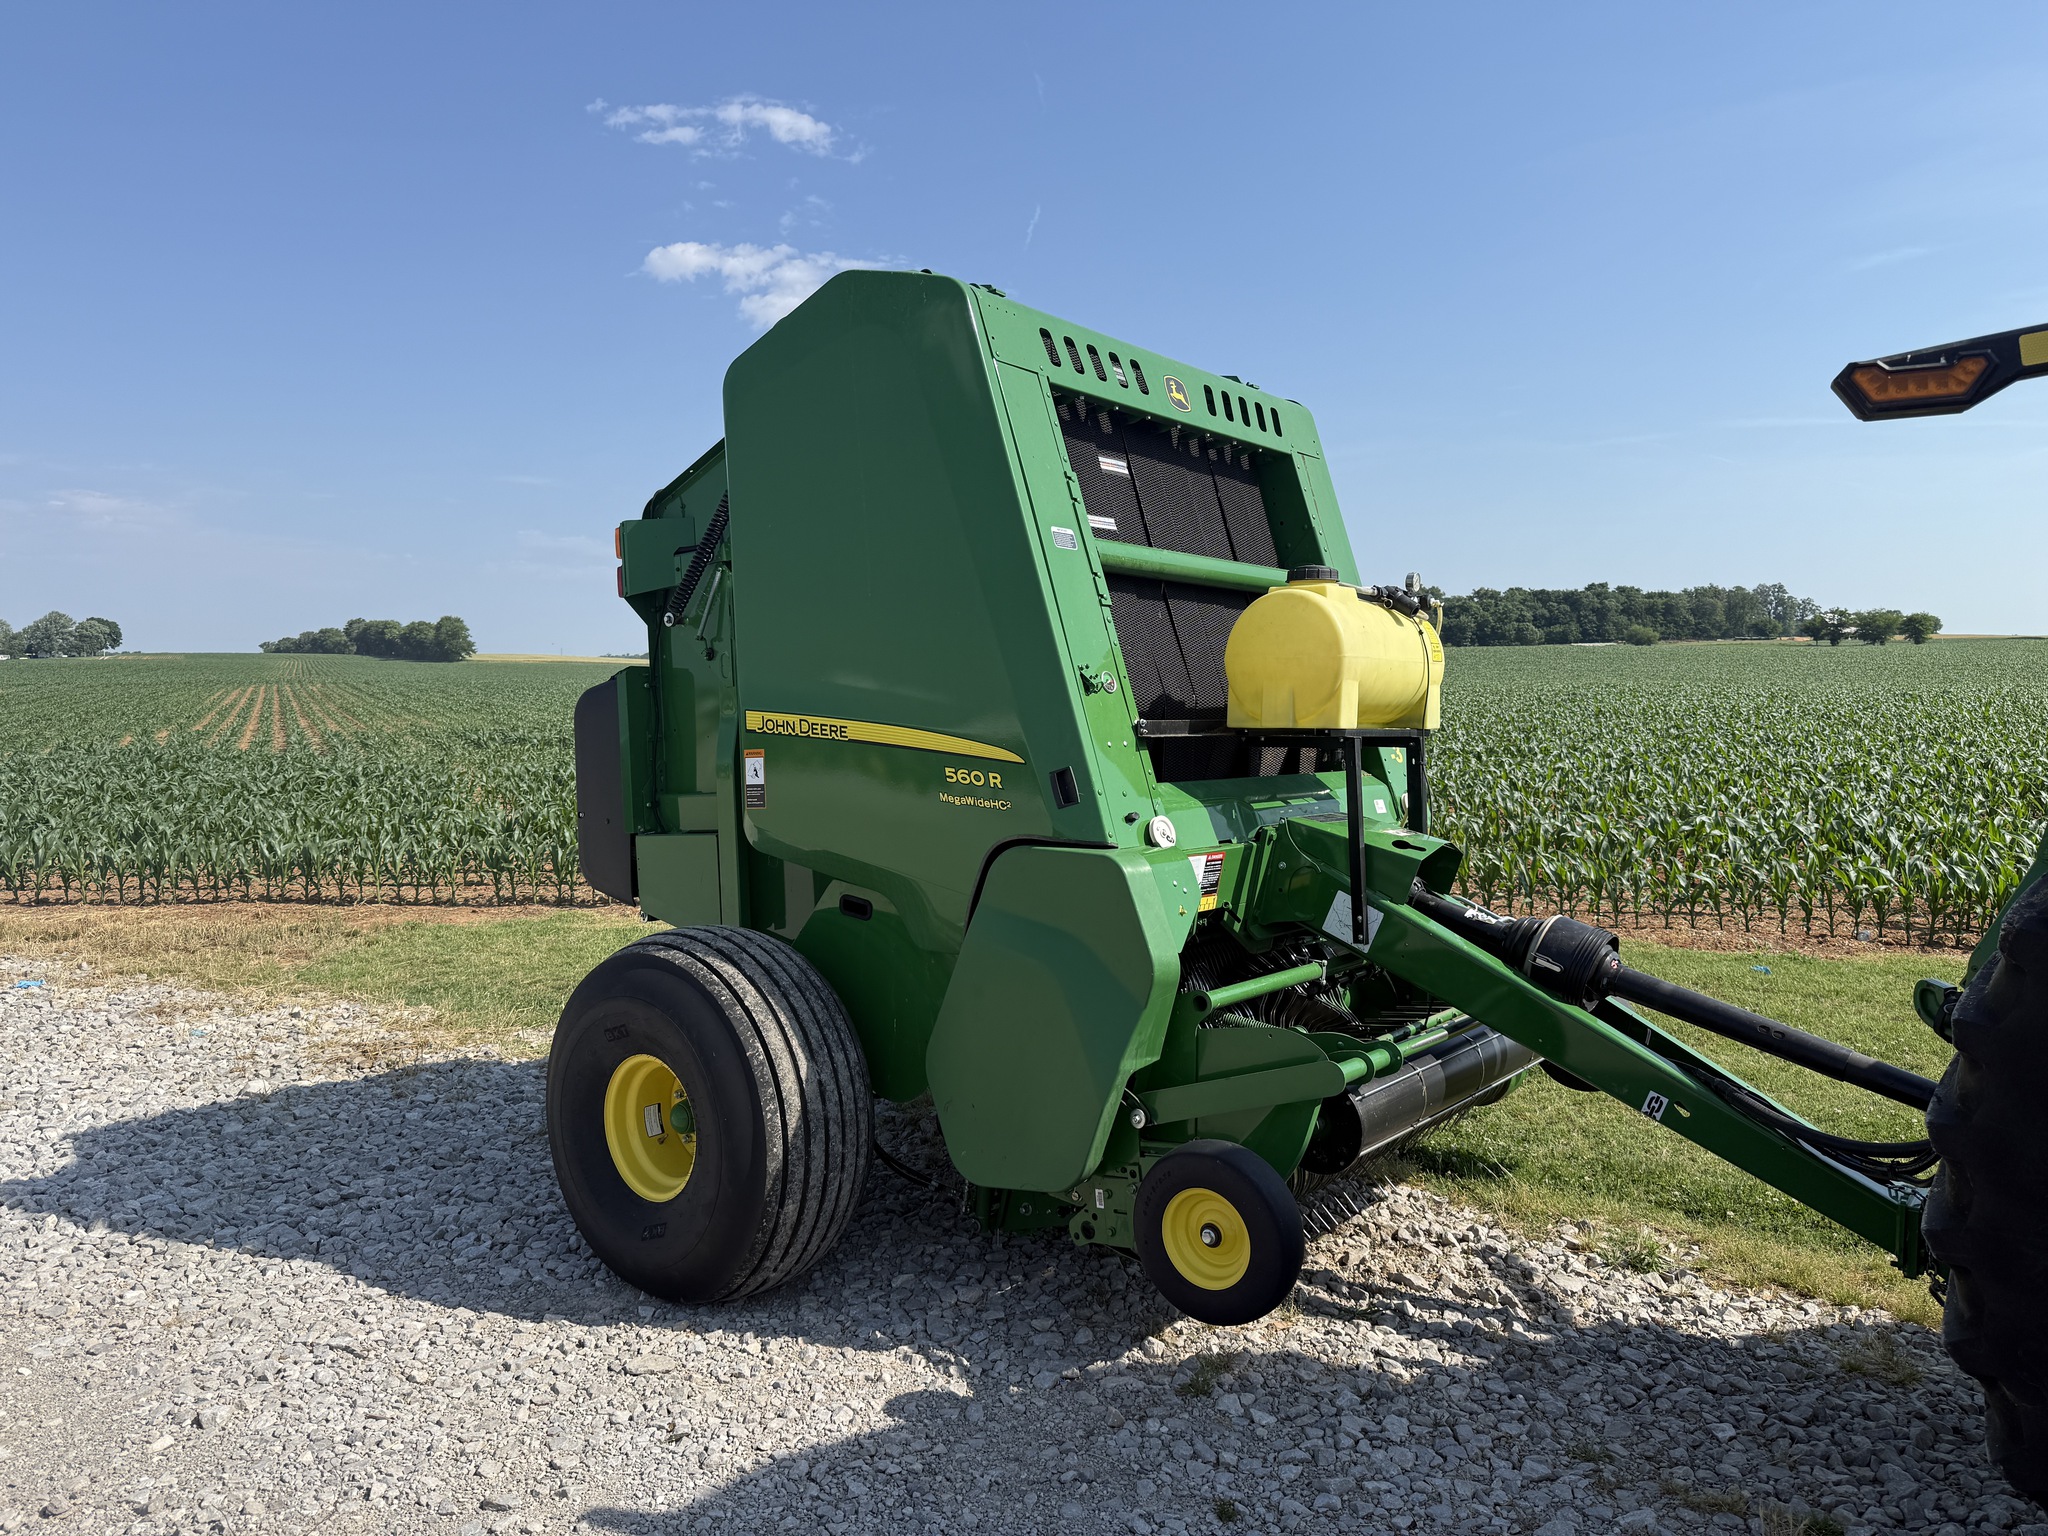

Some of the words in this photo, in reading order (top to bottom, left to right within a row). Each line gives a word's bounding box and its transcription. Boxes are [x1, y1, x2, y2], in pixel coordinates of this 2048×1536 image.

[757, 715, 796, 733] JOHN
[799, 718, 848, 739] DEERE
[945, 767, 985, 786] 560
[988, 772, 1003, 789] R
[604, 1024, 629, 1042] BKT
